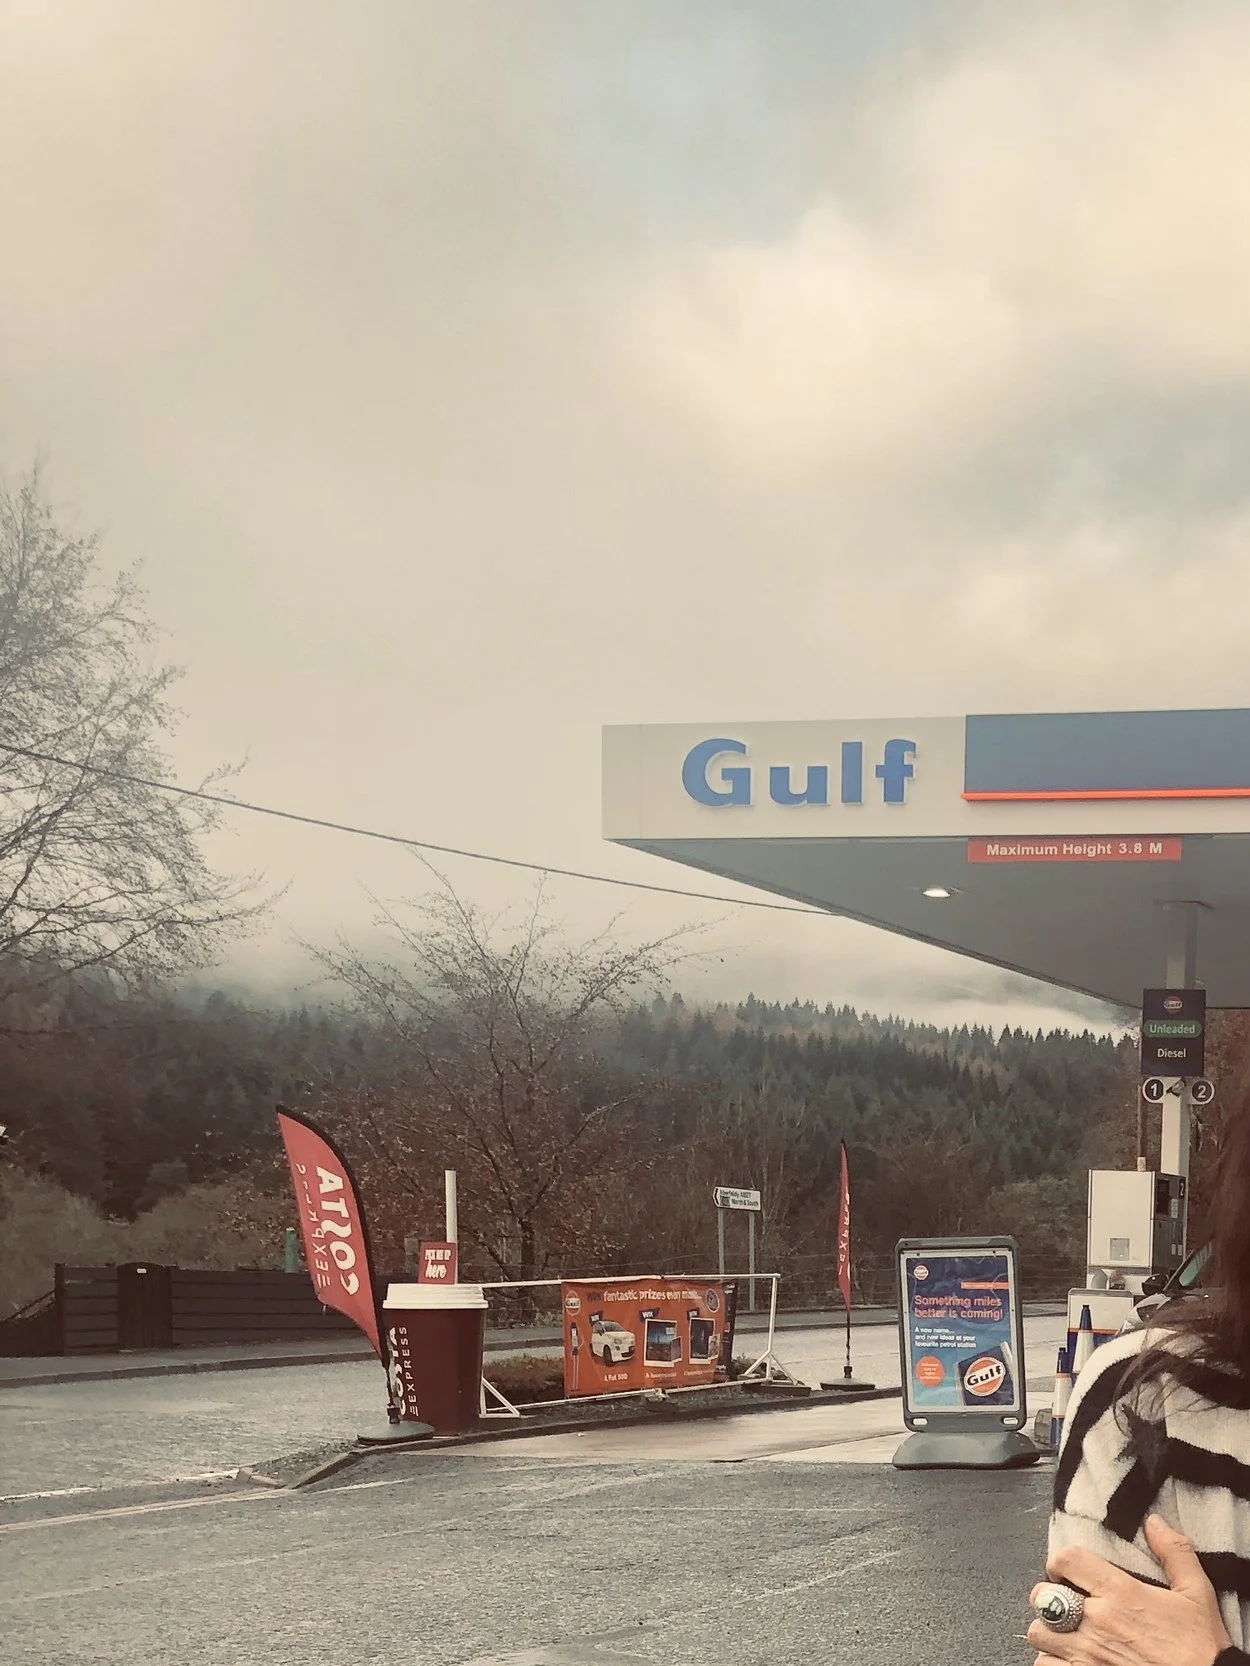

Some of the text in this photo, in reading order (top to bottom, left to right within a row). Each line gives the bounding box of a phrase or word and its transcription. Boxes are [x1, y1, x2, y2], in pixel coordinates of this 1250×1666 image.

[682, 737, 917, 808] Gulf
[986, 842, 1162, 858] Maximum Height 3.8 M
[1149, 1024, 1196, 1034] Unleaded
[1157, 1048, 1187, 1058] Diesel
[1150, 1083, 1207, 1099] 1 2
[425, 1259, 447, 1279] here
[603, 1289, 638, 1303] fantastic
[639, 1288, 665, 1302] prizes
[914, 1295, 1002, 1308] Something miles
[914, 1307, 1003, 1321] better is coming!
[399, 1326, 417, 1403] EXPRESS
[966, 1365, 1002, 1386] Gulf
